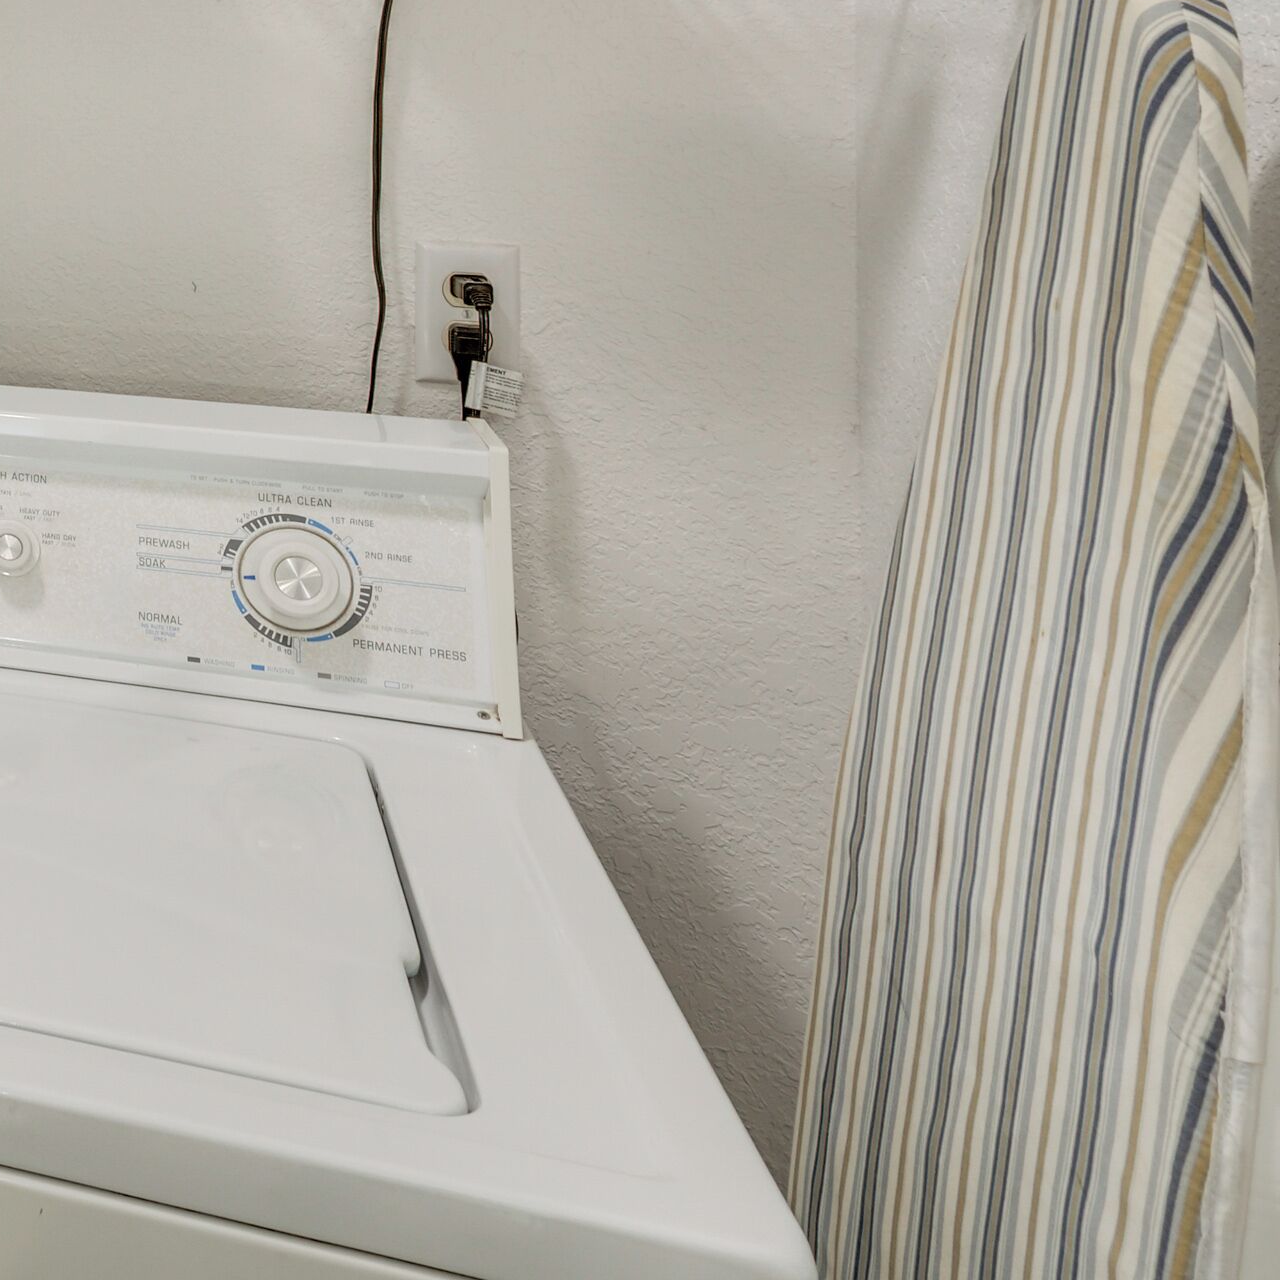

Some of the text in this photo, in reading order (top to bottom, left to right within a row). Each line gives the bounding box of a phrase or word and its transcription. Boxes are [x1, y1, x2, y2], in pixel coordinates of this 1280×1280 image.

[11, 472, 47, 484] ACTION
[258, 492, 332, 508] ULTRA CLEAN
[19, 507, 61, 517] HEAVY DUTY
[349, 518, 375, 528] RINSE
[138, 536, 190, 550] PREWASH
[138, 557, 166, 568] SOAK
[365, 552, 413, 563] 2ND RINSE
[374, 585, 383, 593] 10
[138, 611, 183, 625] NORMAL
[352, 638, 467, 662] PERMANENT PRESS
[204, 658, 236, 668] WASHING
[334, 674, 368, 685] SPINNING
